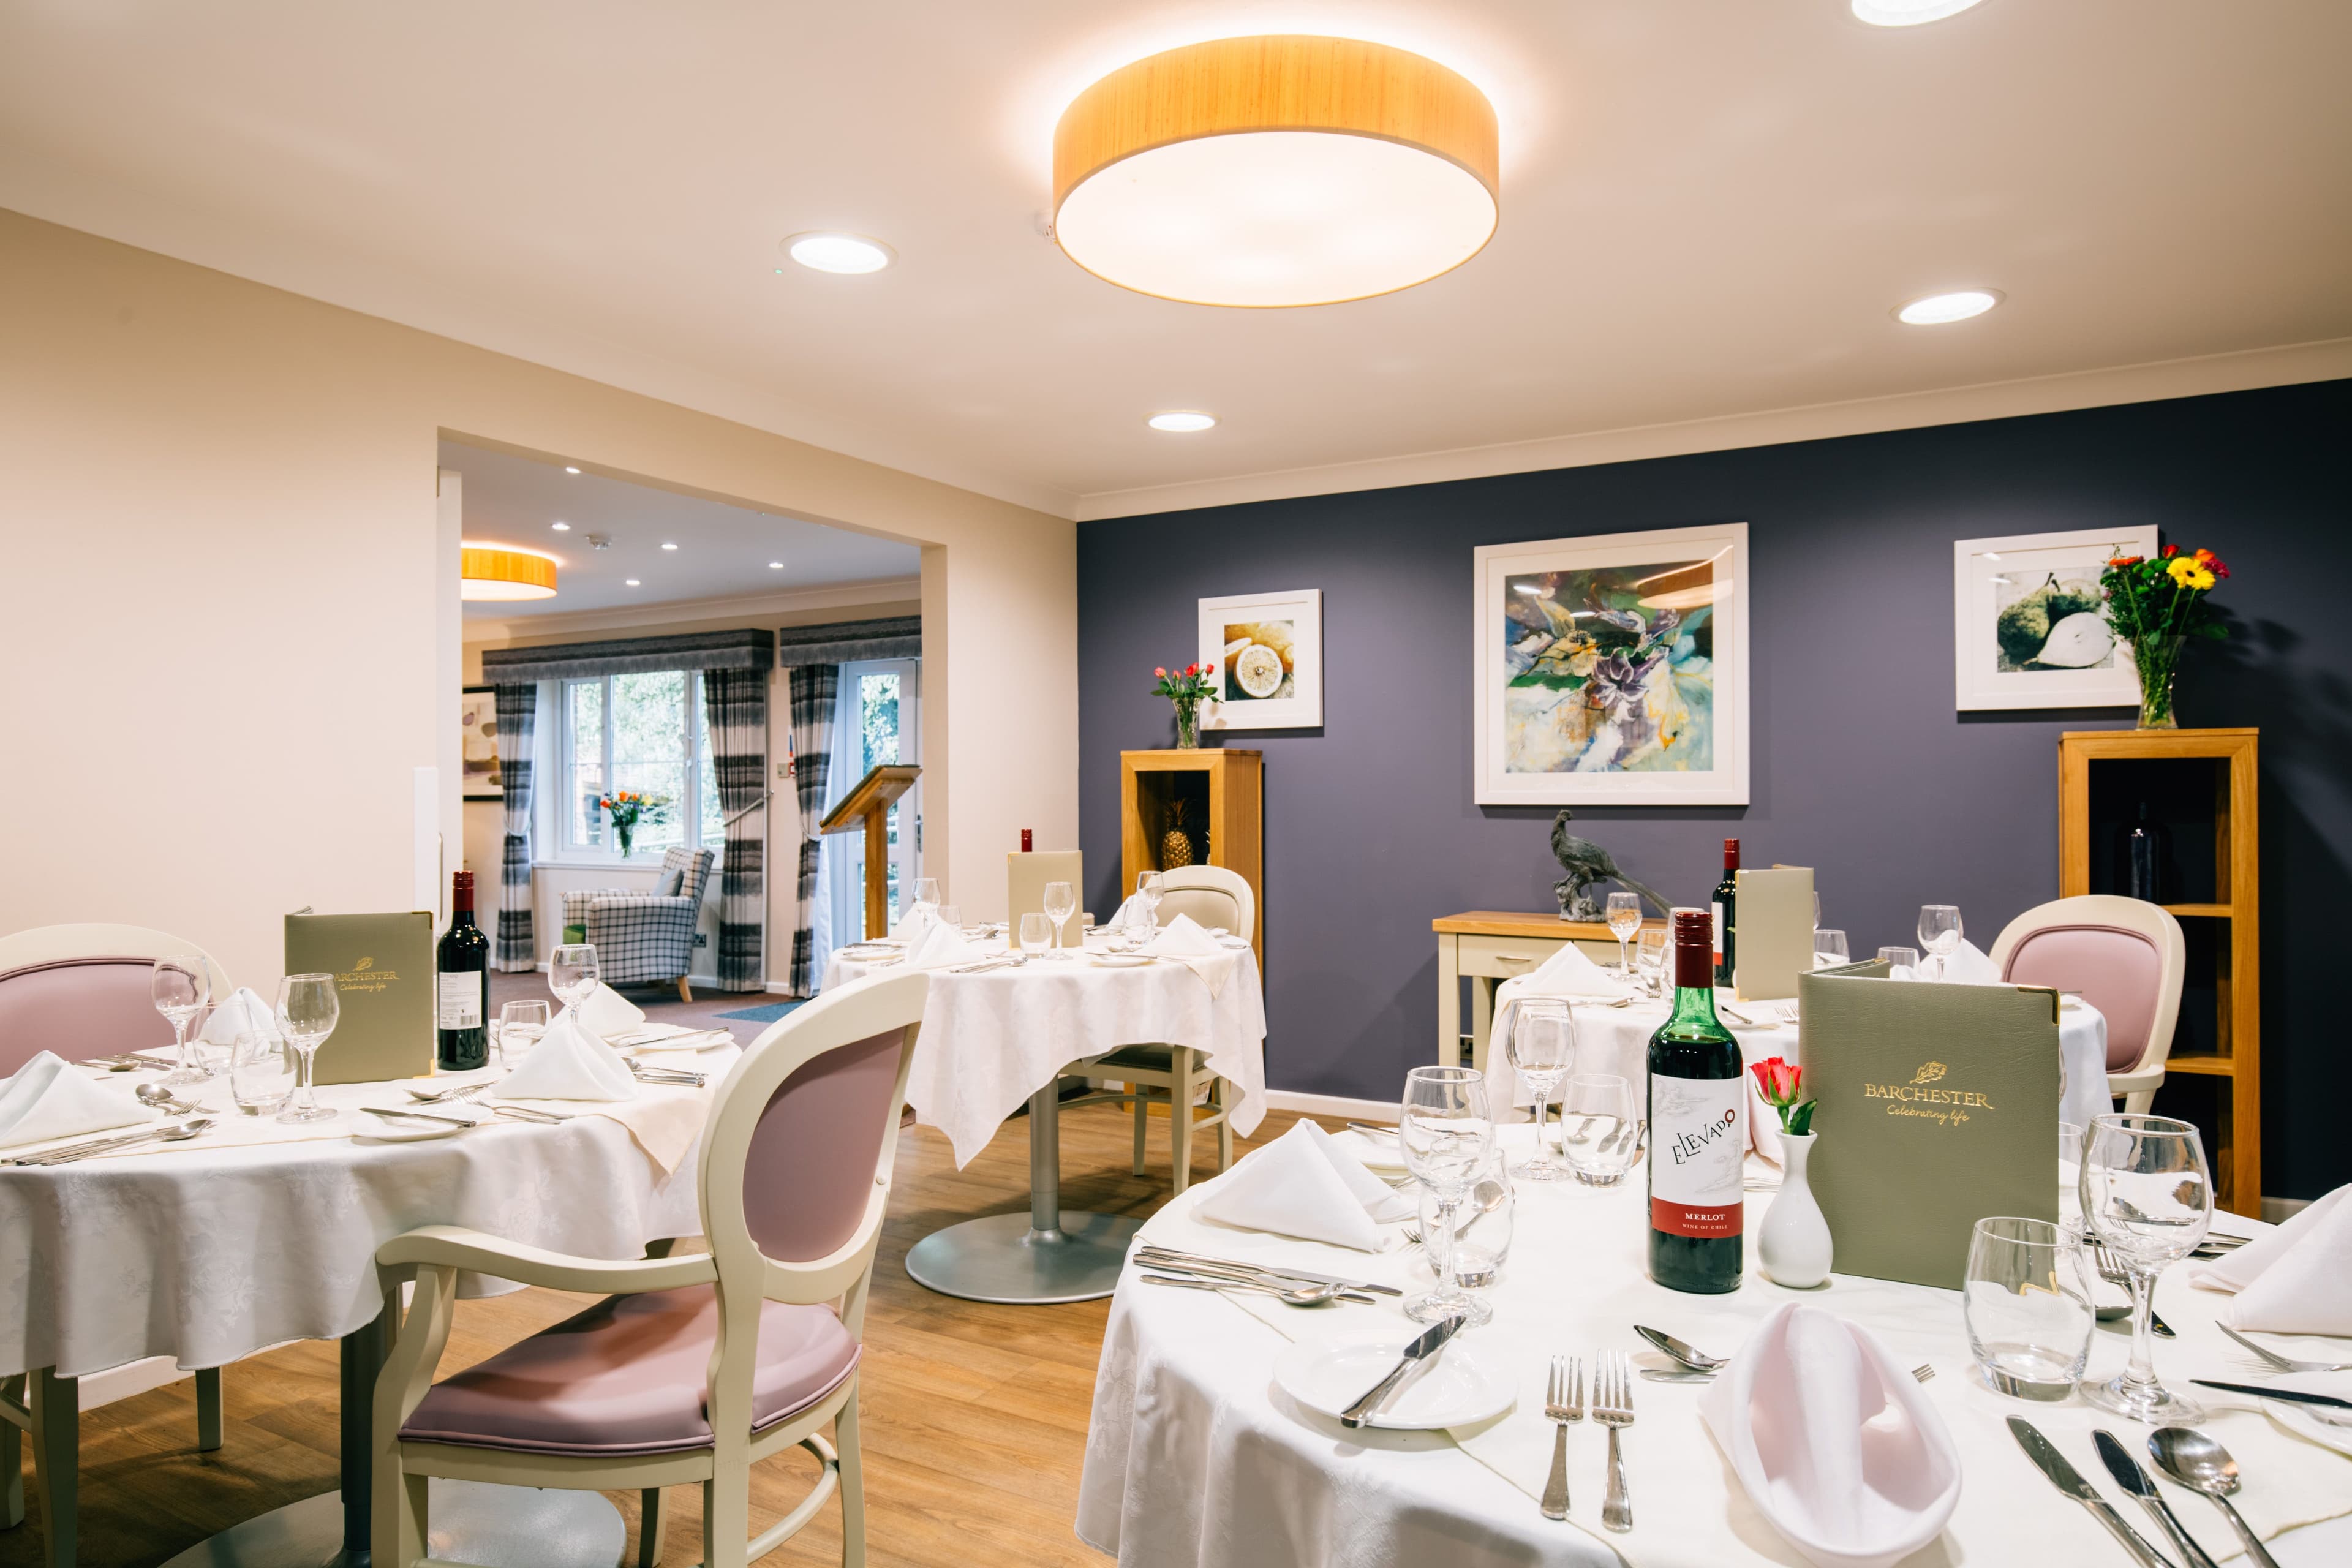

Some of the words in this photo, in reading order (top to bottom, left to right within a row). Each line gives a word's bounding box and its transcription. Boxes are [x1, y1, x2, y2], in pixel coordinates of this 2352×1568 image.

[333, 971, 401, 982] ARCHESTER
[1864, 1084, 1995, 1110] BARCHESTER
[1887, 1104, 1948, 1125] Celebrating
[1950, 1109, 1970, 1126] life
[1670, 1109, 1735, 1165] ELEVADO
